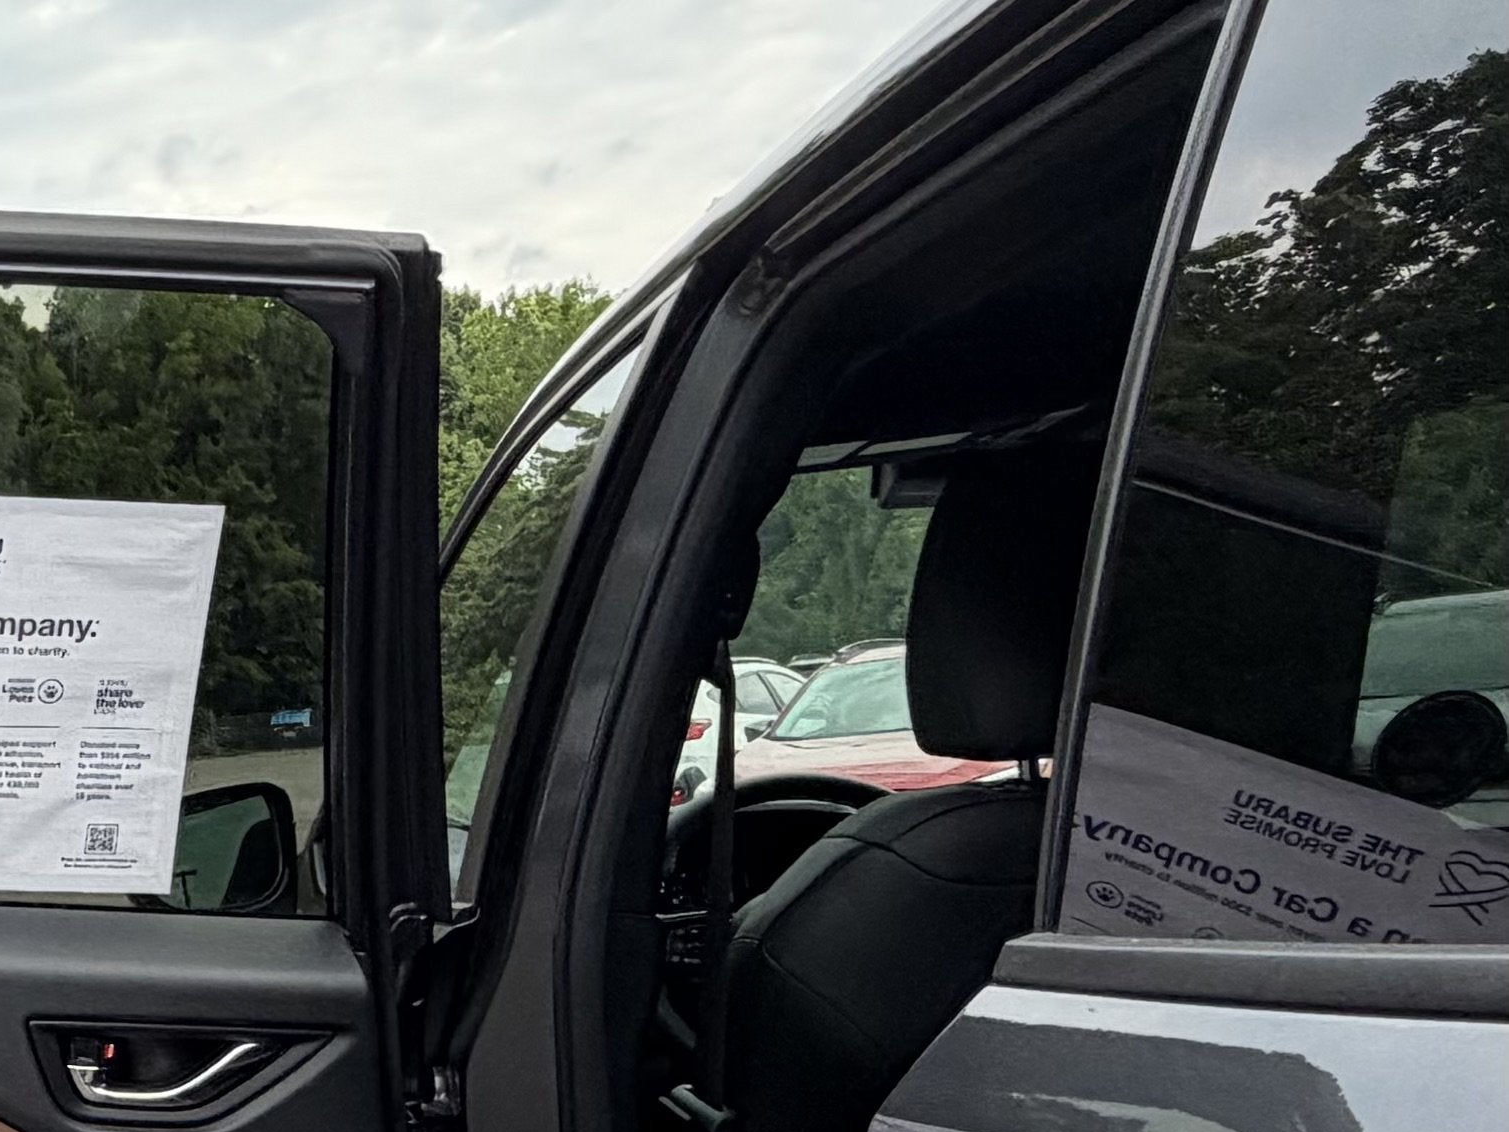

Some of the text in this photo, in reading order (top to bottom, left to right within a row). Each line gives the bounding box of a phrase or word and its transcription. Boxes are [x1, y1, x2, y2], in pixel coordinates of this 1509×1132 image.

[13, 646, 24, 655] to
[96, 687, 133, 698] share
[96, 698, 145, 709] the love
